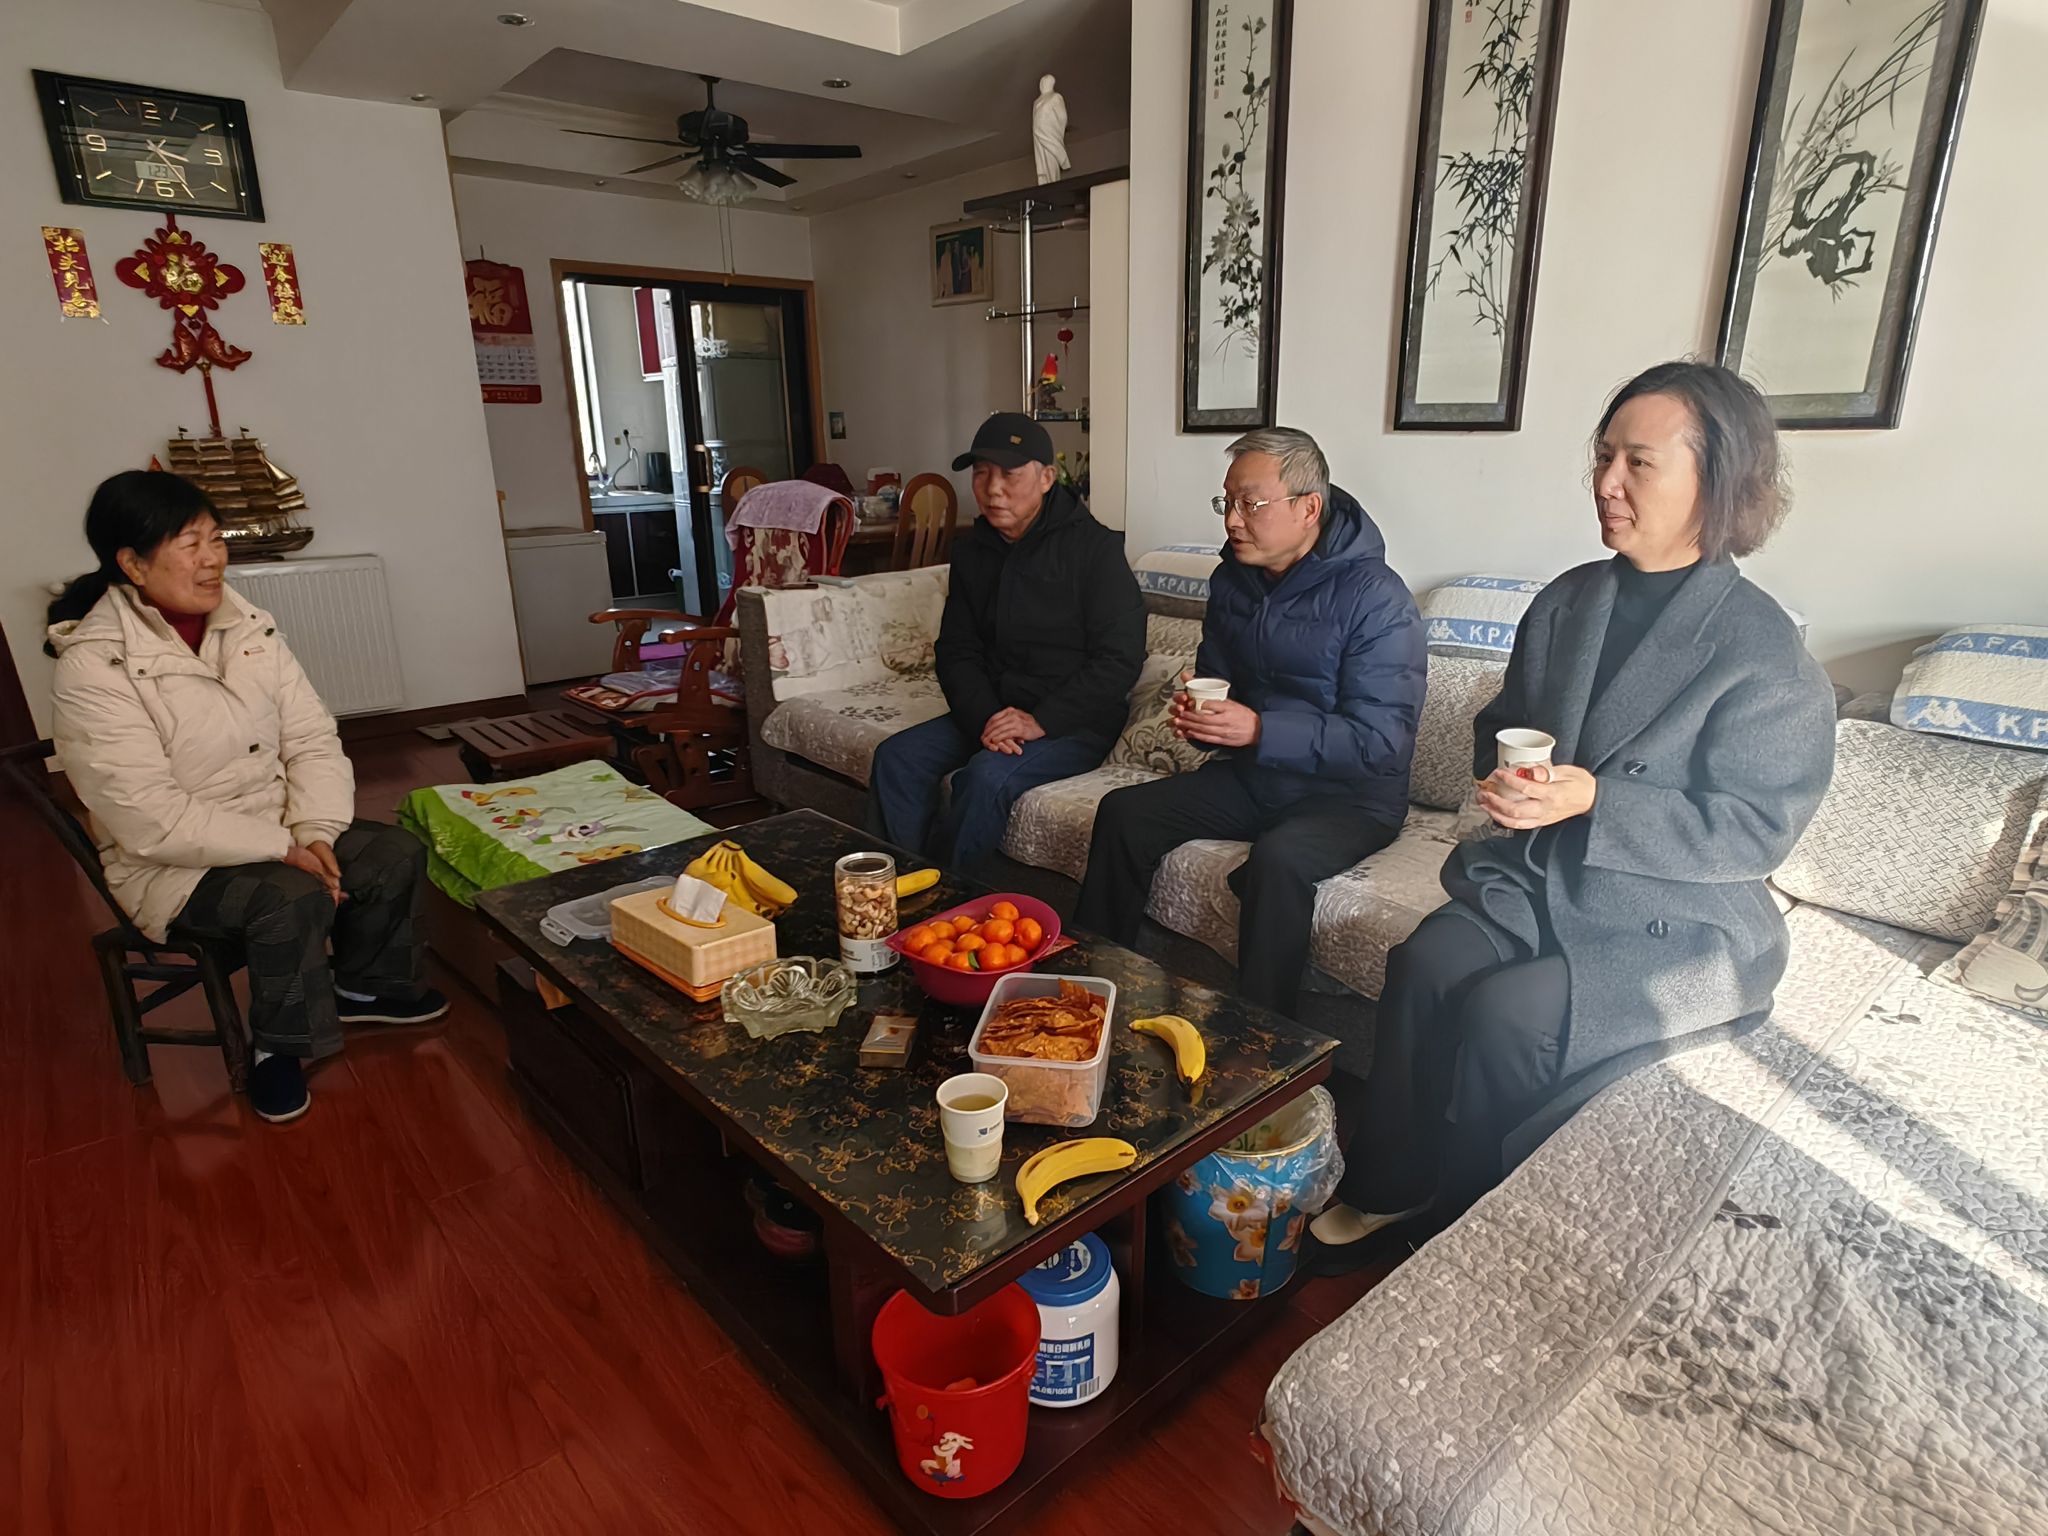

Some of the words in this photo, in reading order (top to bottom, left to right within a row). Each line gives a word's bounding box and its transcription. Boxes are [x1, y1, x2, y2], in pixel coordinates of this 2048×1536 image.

[85, 134, 107, 152] 9
[203, 148, 223, 166] 3
[155, 180, 175, 198] 6
